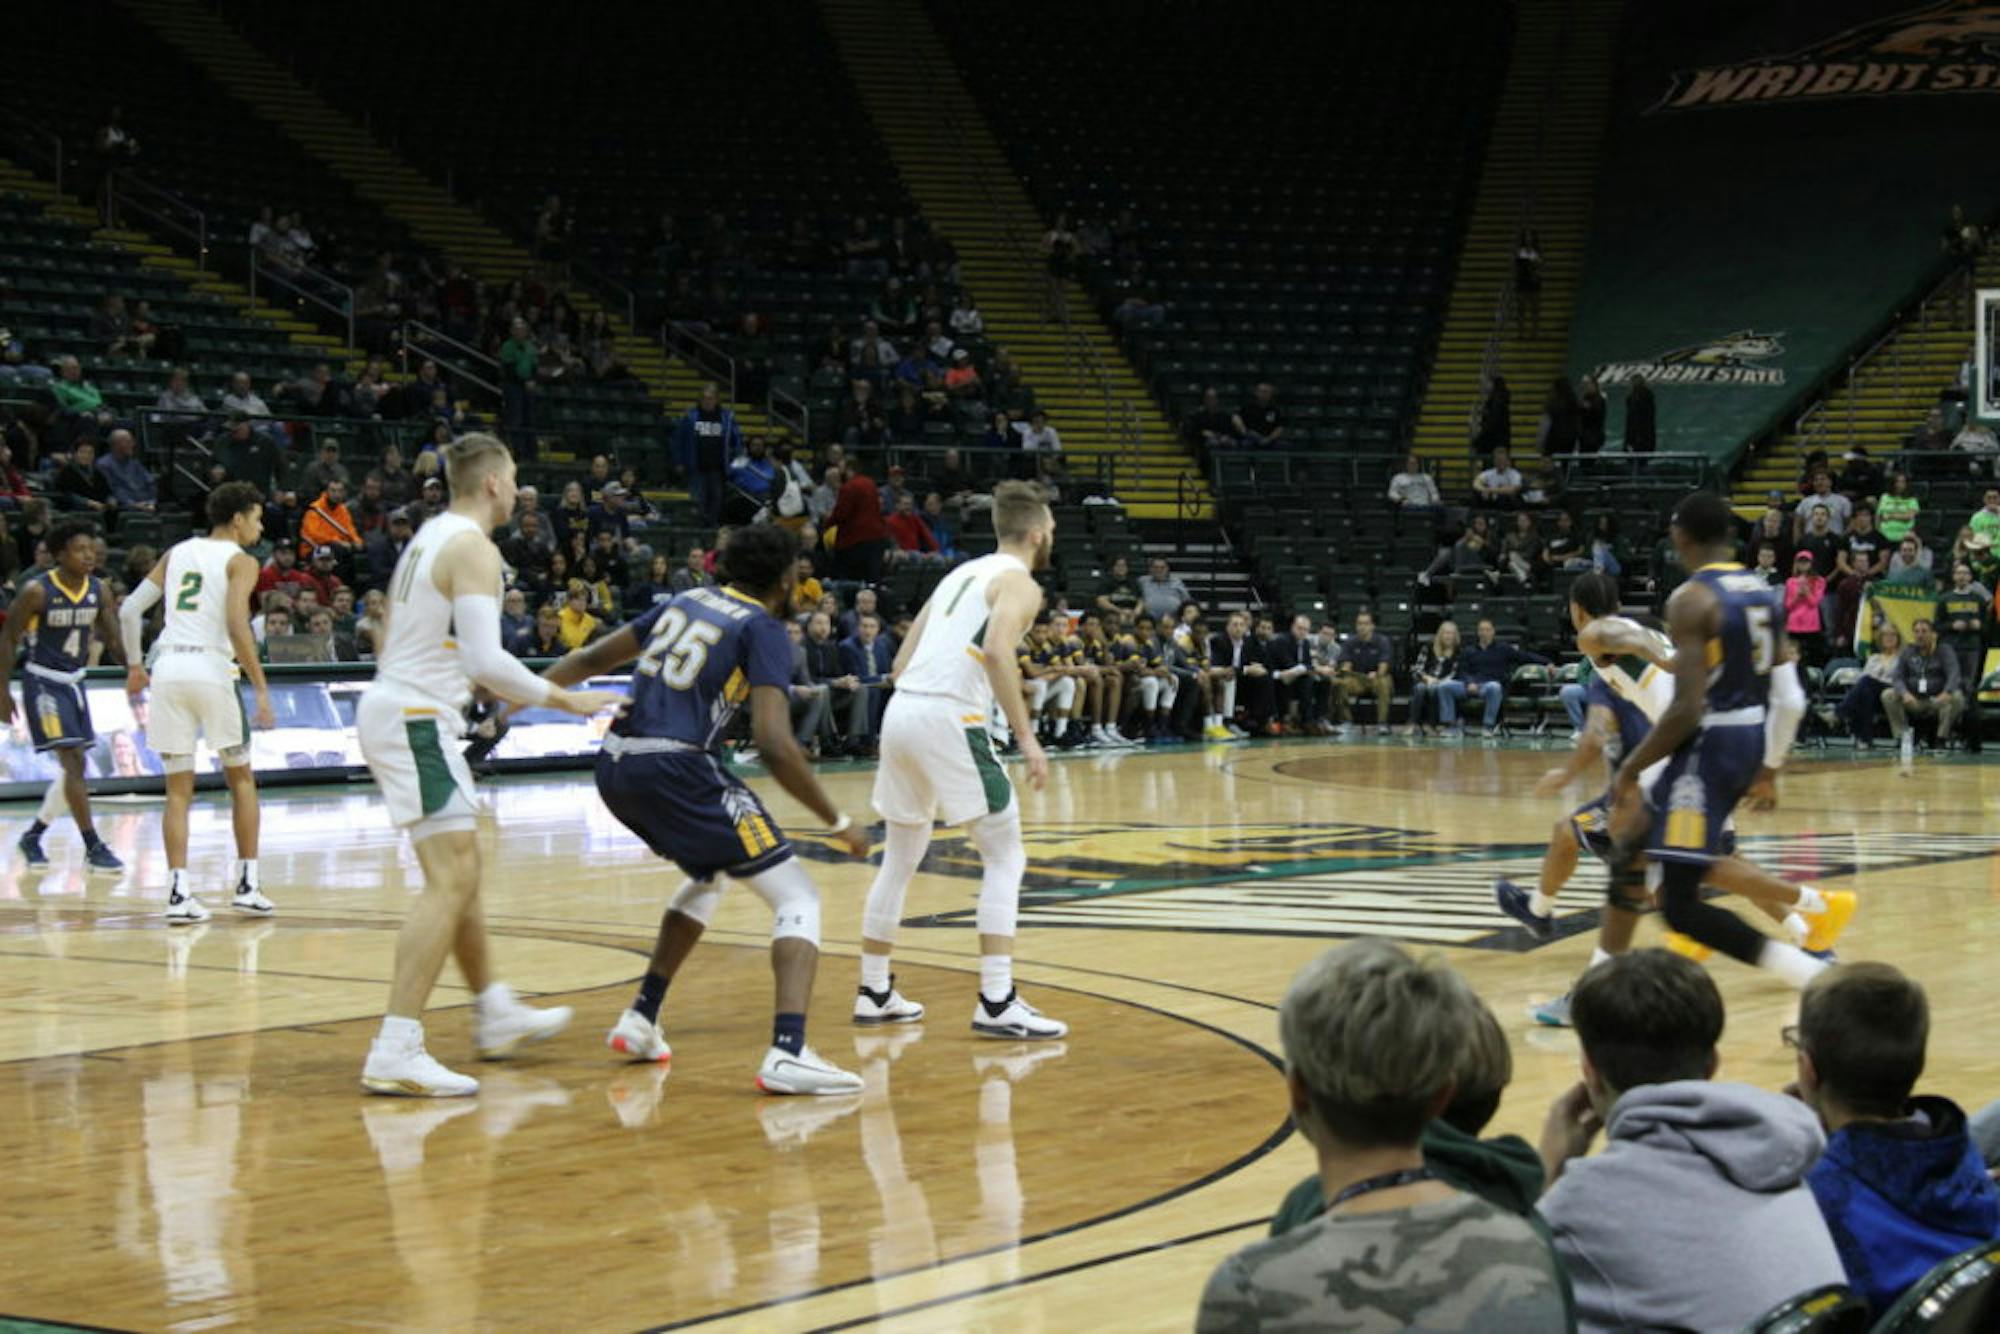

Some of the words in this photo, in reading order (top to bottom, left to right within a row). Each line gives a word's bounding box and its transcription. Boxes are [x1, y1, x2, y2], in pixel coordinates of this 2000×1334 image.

[1672, 62, 1929, 106] WRIGHT
[1931, 63, 2000, 90] ST
[1597, 364, 1711, 383] WRIGHT
[1714, 368, 1783, 384] STATE
[176, 571, 203, 611] 2
[944, 575, 976, 618] 1
[62, 628, 81, 658] 4
[637, 606, 723, 691] 25
[1744, 605, 1774, 675] 5
